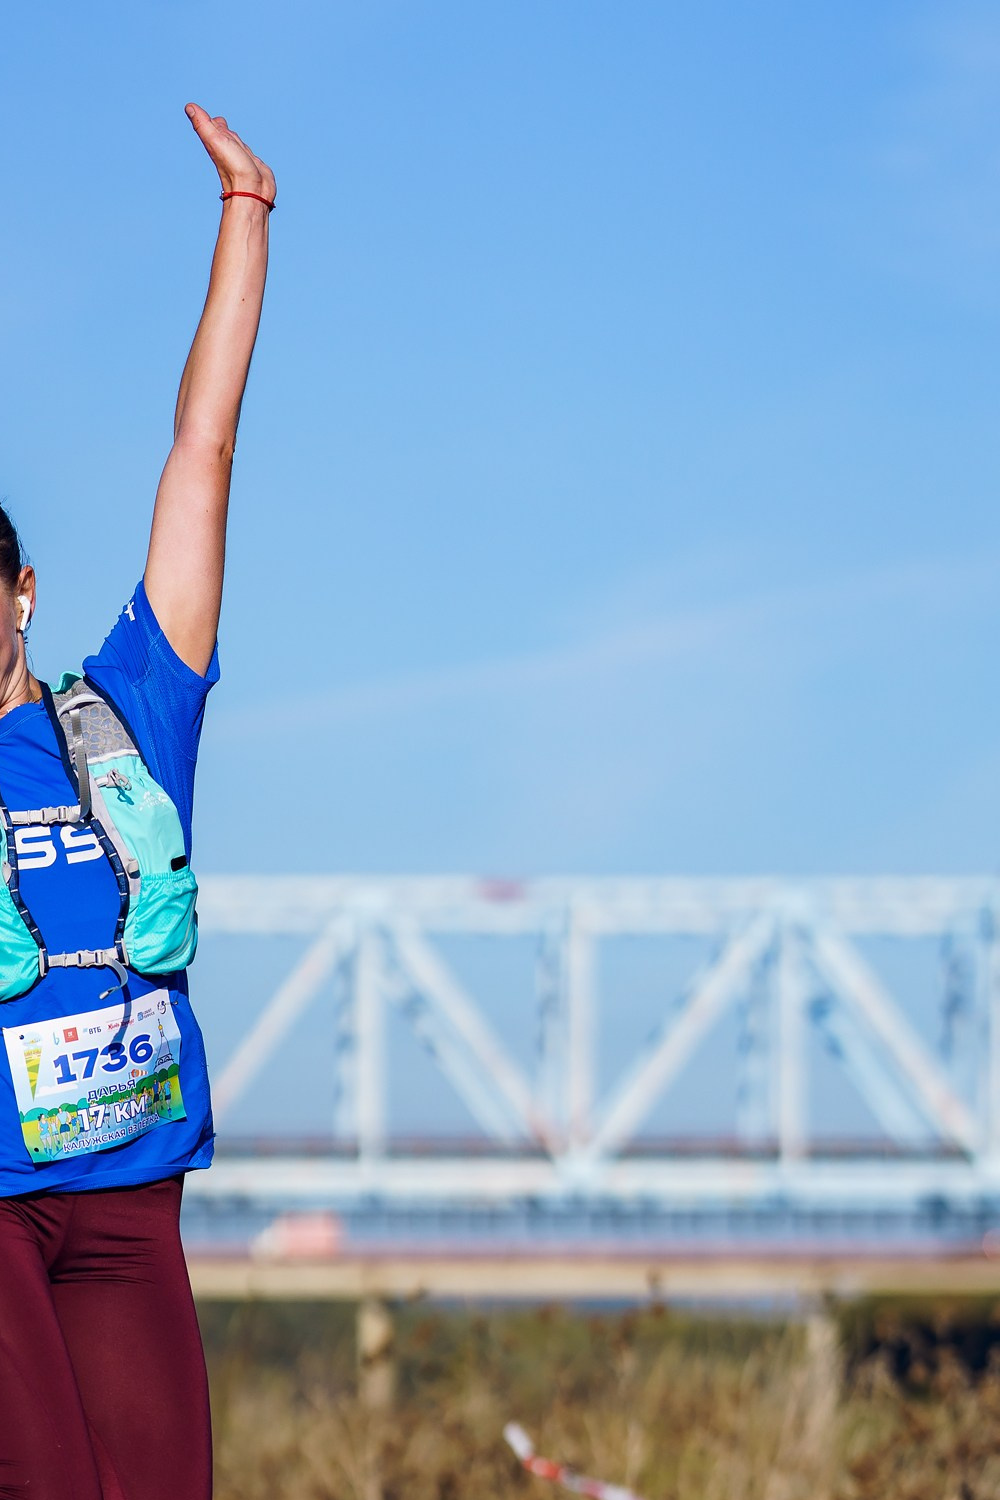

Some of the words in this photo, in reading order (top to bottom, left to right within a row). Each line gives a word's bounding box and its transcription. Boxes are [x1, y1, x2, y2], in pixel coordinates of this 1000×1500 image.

[53, 1034, 154, 1085] 1736
[87, 1079, 136, 1102] ДАРЬЯ
[77, 1103, 106, 1133] 17
[114, 1094, 146, 1124] КМ
[63, 1128, 126, 1152] КАЛУЖСКАЯ
